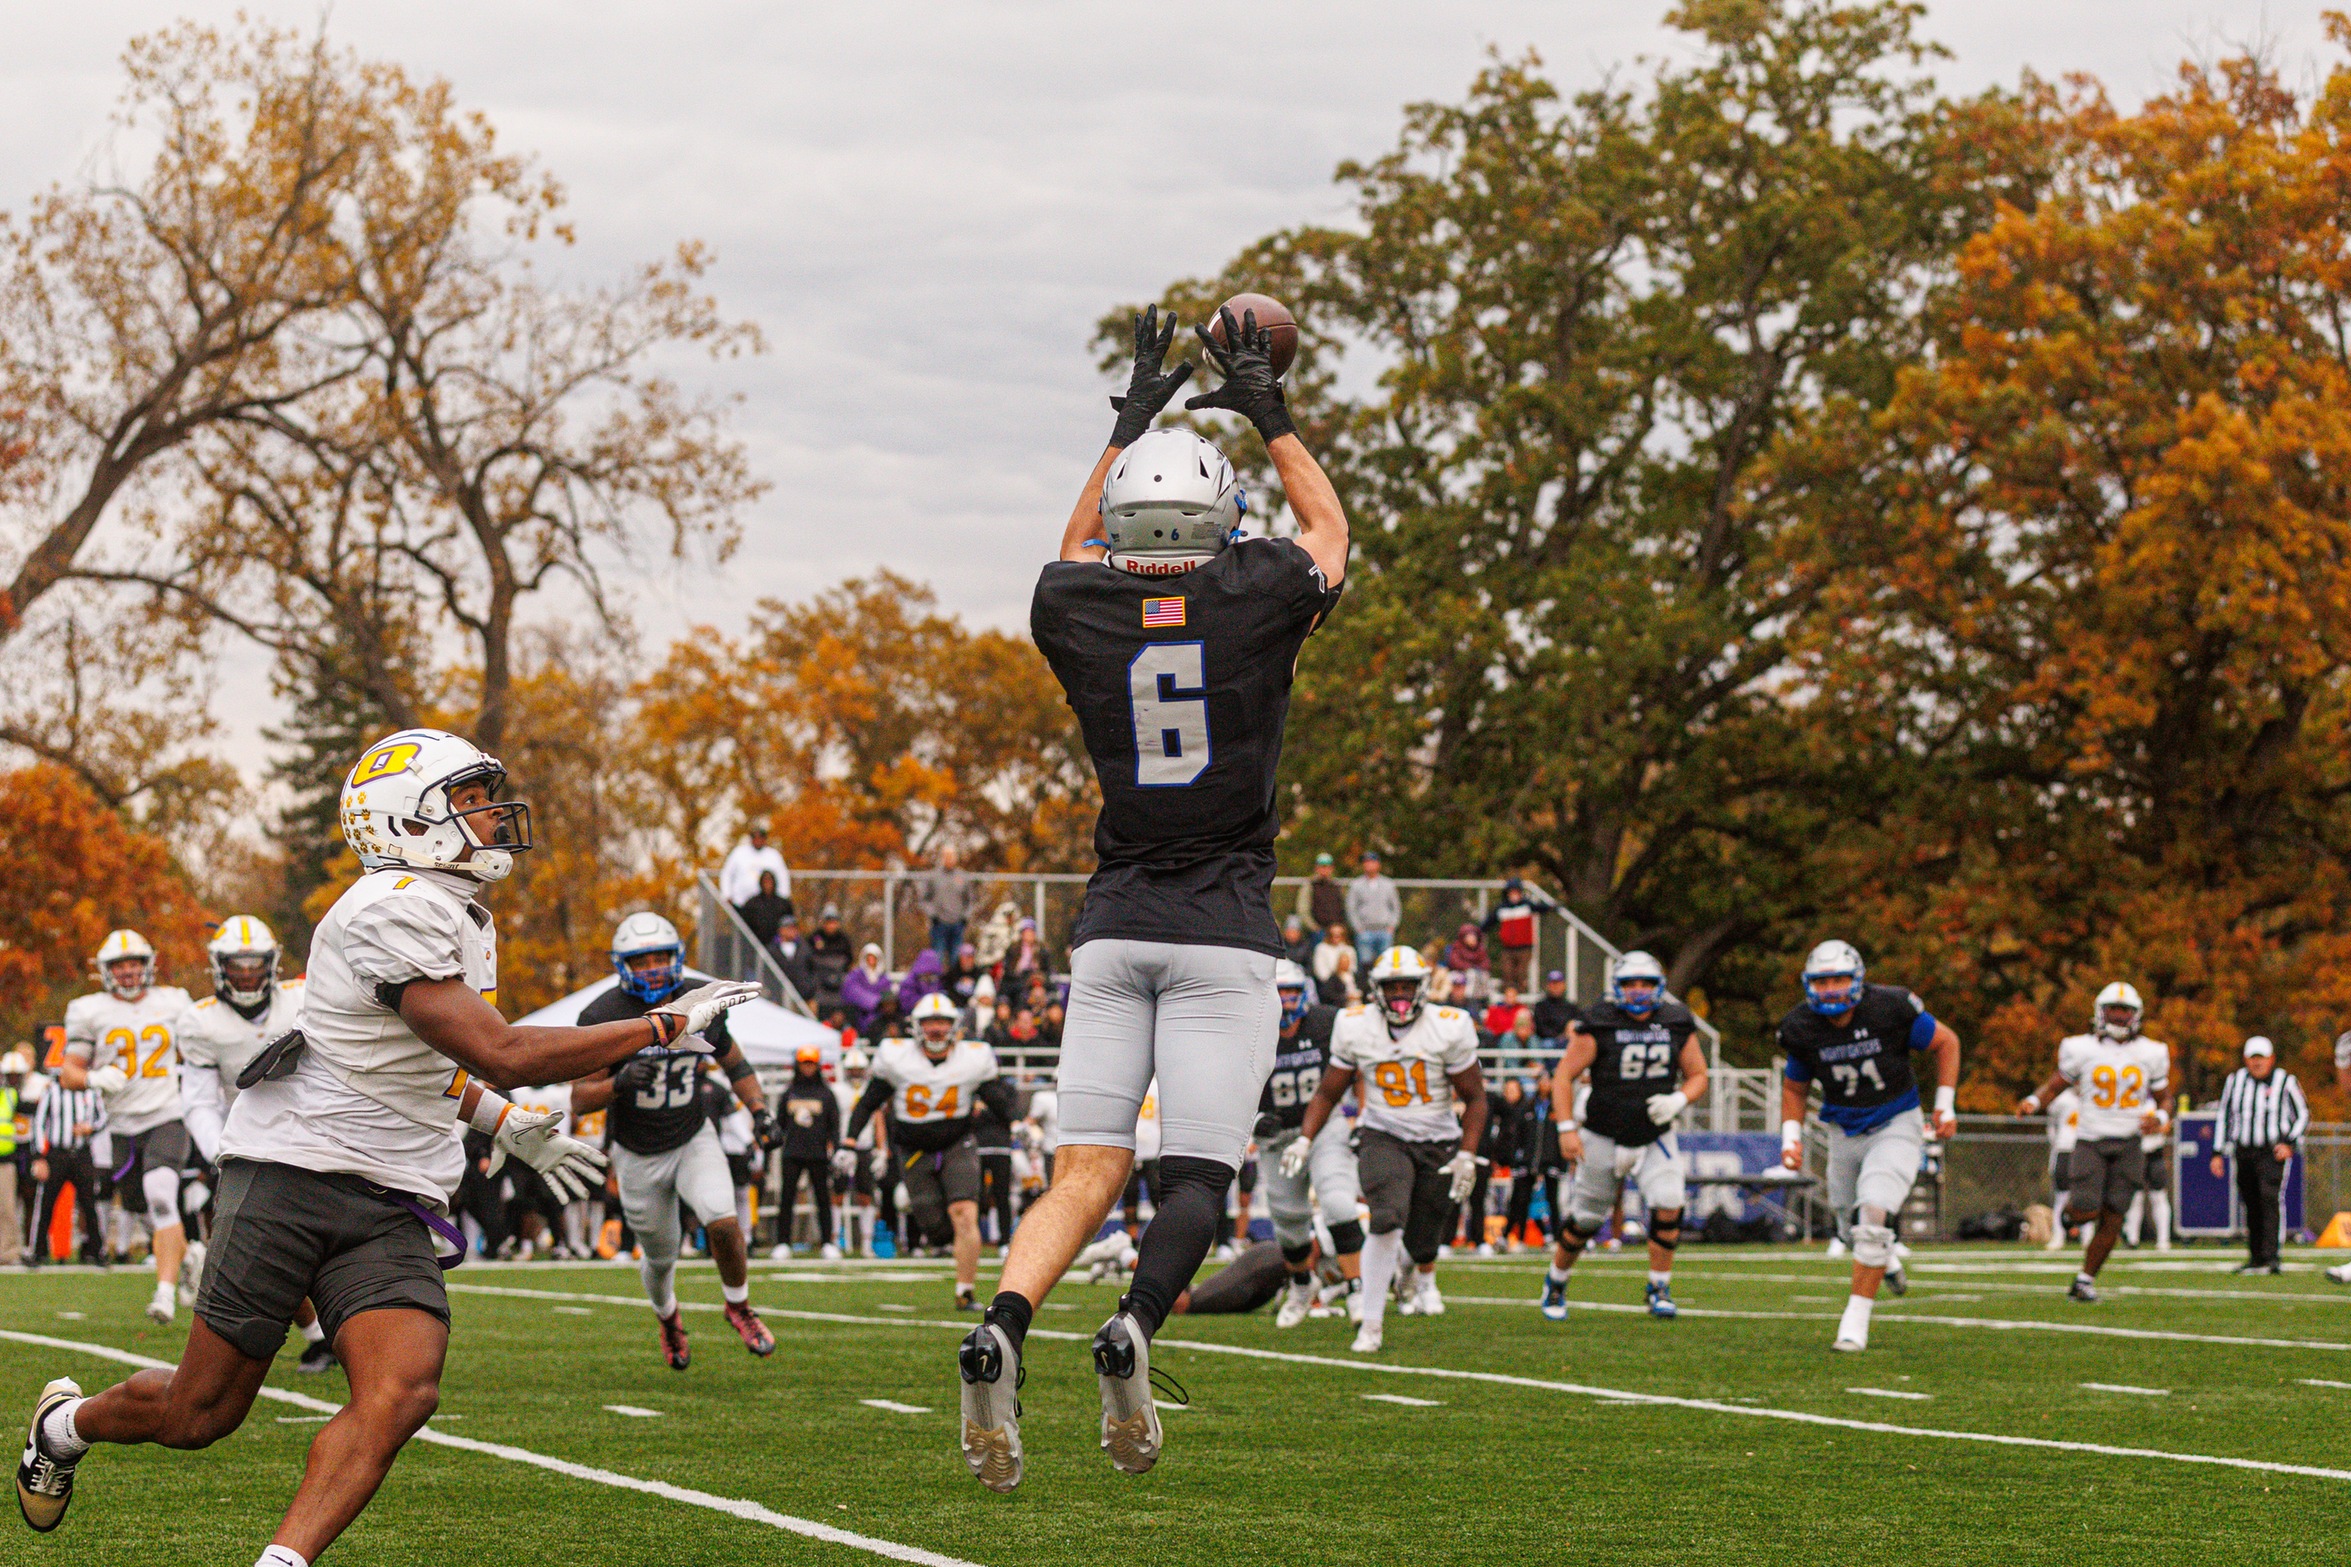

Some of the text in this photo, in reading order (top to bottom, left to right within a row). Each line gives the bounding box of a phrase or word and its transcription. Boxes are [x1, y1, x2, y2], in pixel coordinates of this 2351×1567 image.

[1171, 528, 1180, 541] 6
[1126, 559, 1196, 575] Riddell
[1127, 640, 1213, 787] 6
[105, 1024, 171, 1080] 32
[1620, 1043, 1670, 1079] 62
[636, 1054, 698, 1110] 33
[1375, 1060, 1433, 1107] 91
[1831, 1058, 1886, 1098] 71
[2092, 1065, 2143, 1109] 92
[905, 1083, 959, 1119] 64
